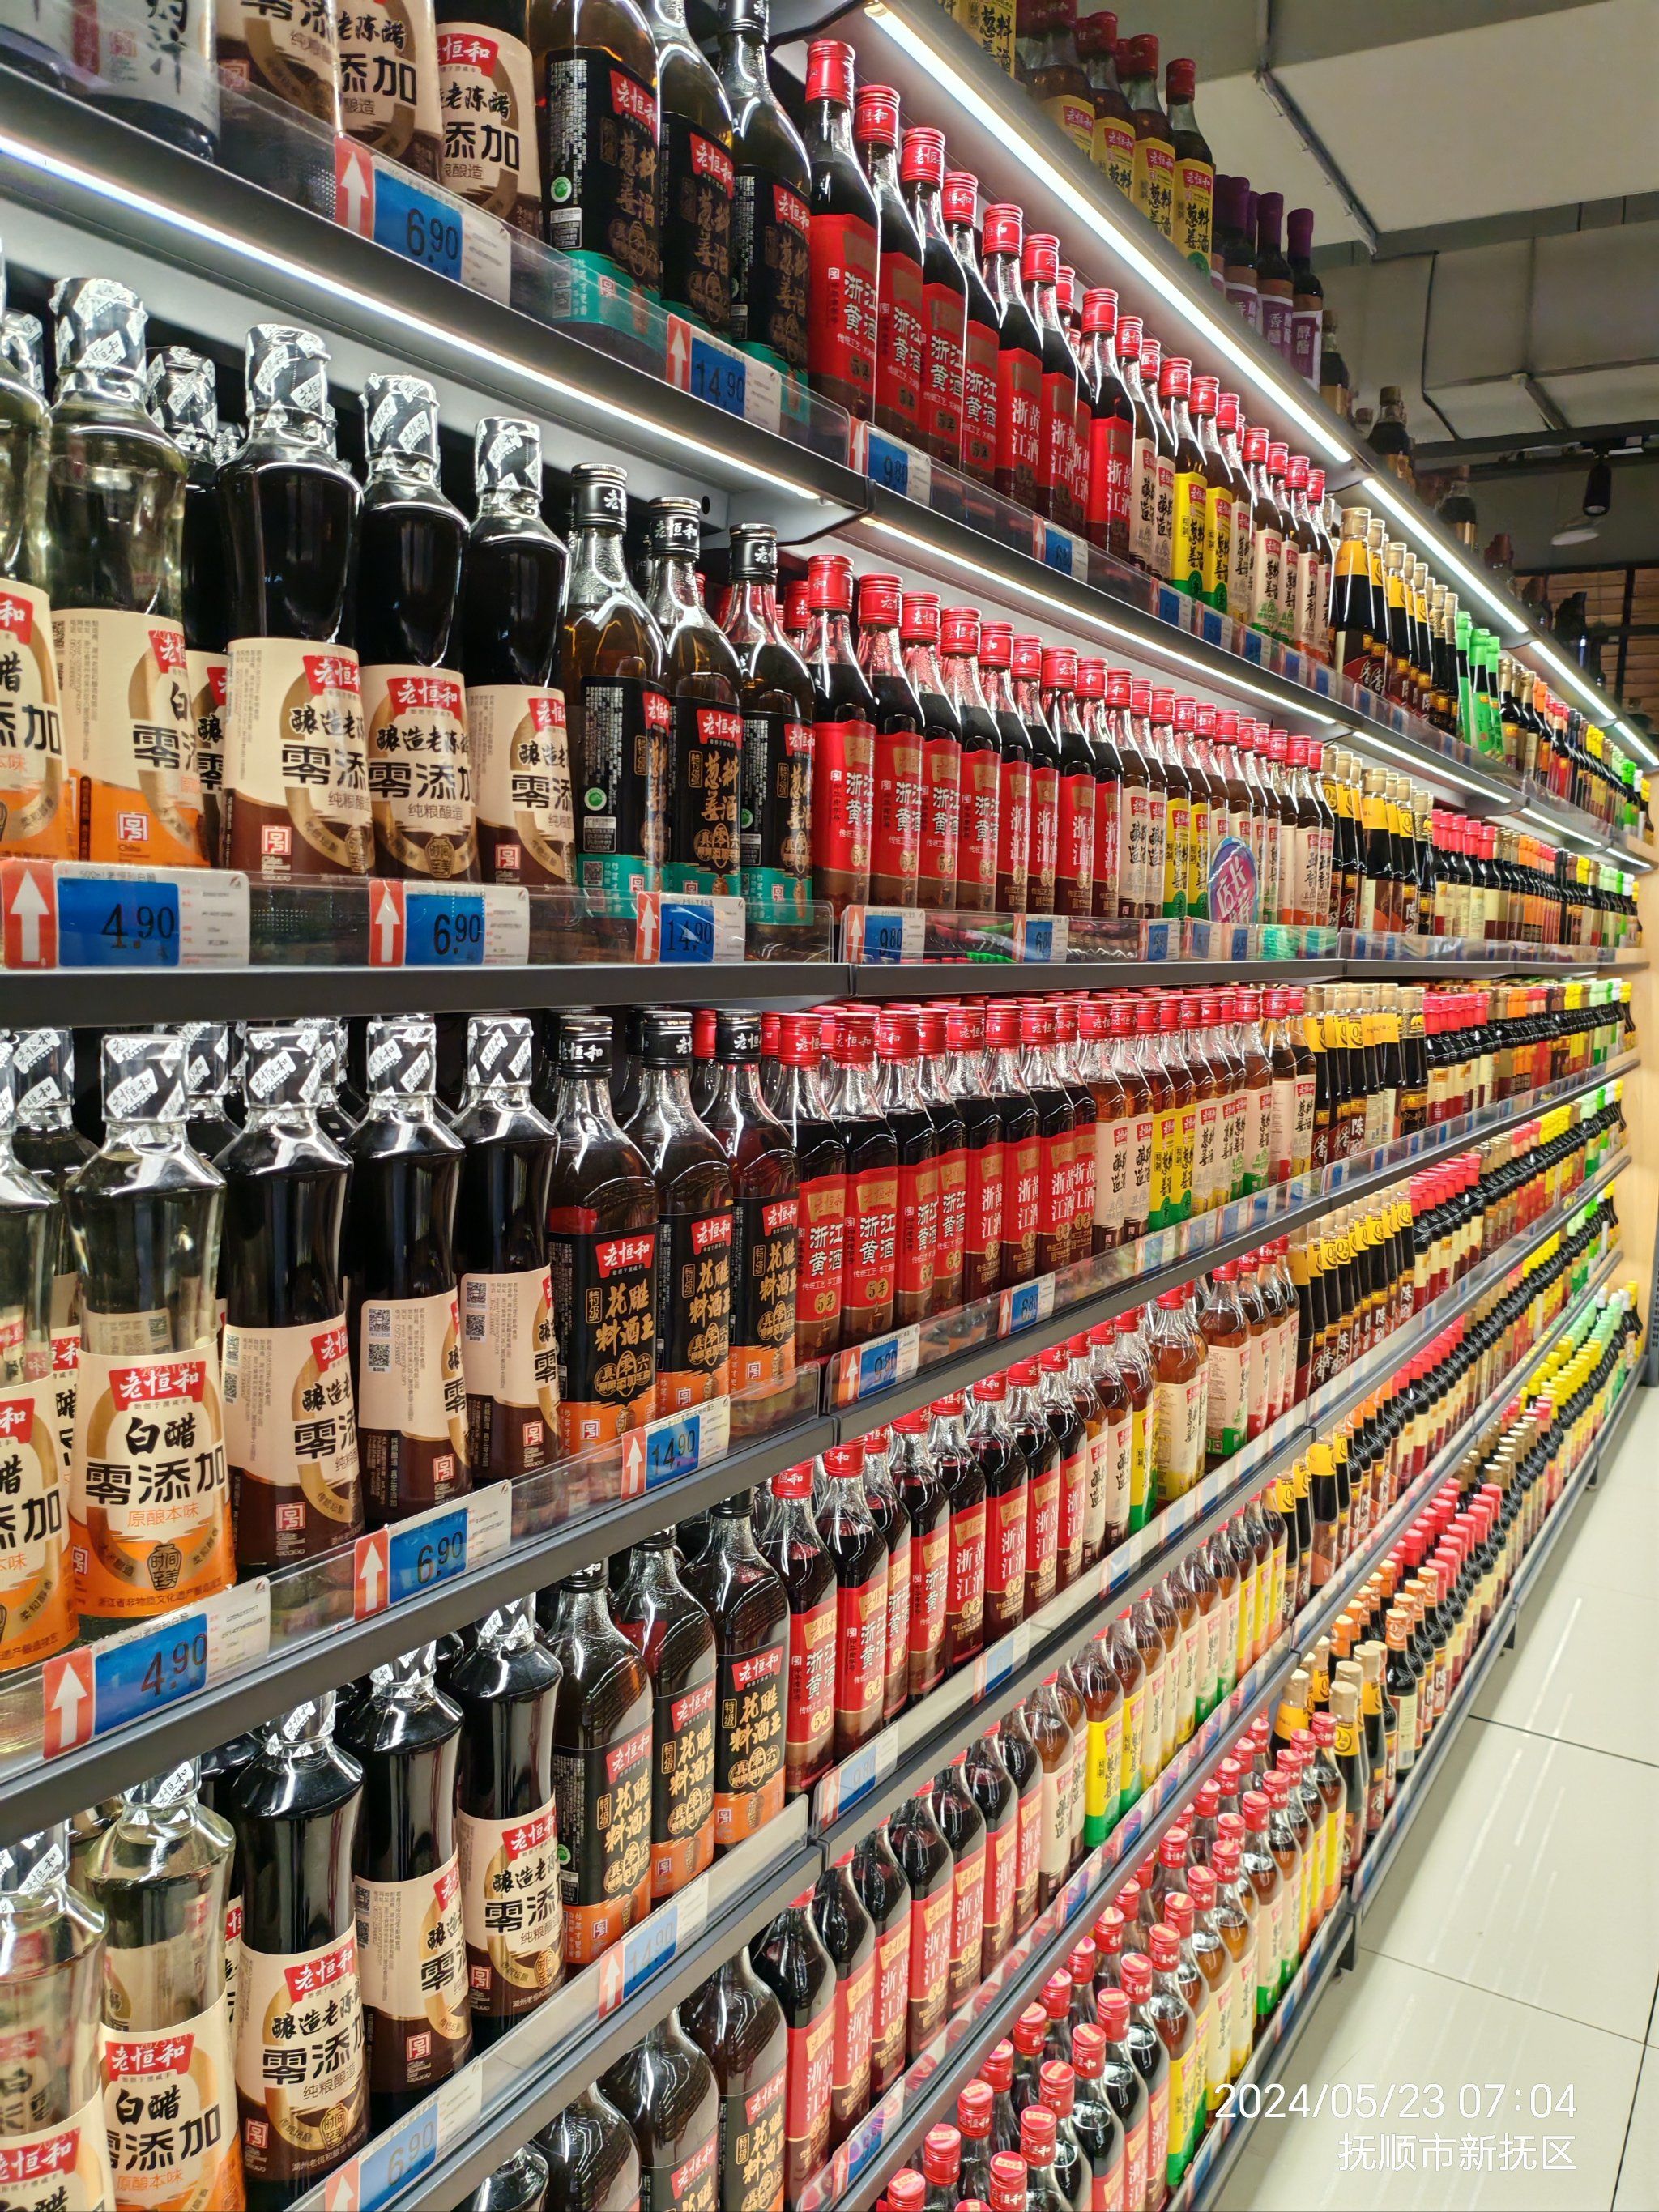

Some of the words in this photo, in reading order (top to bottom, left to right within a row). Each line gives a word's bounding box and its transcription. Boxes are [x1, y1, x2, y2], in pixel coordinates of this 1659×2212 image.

[616, 82, 659, 126] 老恒和
[1107, 128, 1134, 149] 老恒和
[697, 143, 733, 185] 老恒和
[1150, 150, 1175, 171] 老恒和
[1187, 169, 1213, 191] 老恒和
[778, 193, 810, 230] 老恒和
[405, 207, 459, 263] 6.90
[844, 271, 876, 309] 浙江
[843, 303, 876, 343] 黄酒
[893, 306, 923, 344] 浙江
[893, 335, 921, 374] 黄酒
[929, 335, 965, 367] 浙江
[696, 360, 744, 405] 14.90
[929, 362, 964, 399] 黄酒
[966, 367, 997, 403] 浙江
[966, 394, 997, 428] 黄酒
[1011, 396, 1029, 459] 浙江
[655, 518, 699, 540] 老恒和
[170, 683, 191, 722] 白
[396, 682, 461, 710] 老恒和
[702, 714, 743, 738] 老恒和
[721, 752, 741, 824] 料酒
[846, 771, 874, 798] 浙江
[895, 781, 923, 805] 浙江
[932, 786, 961, 810] 浙江
[407, 803, 464, 823] 纯粮酿造
[845, 798, 873, 826] 黄酒
[895, 807, 922, 833] 黄酒
[932, 811, 960, 837] 黄酒
[975, 795, 1000, 818] 浙江
[975, 819, 1000, 843] 黄酒
[102, 904, 176, 951] 4.90
[433, 914, 483, 957] 6.90
[766, 1204, 799, 1226] 老恒和
[917, 1198, 939, 1226] 浙江
[942, 1191, 966, 1214] 浙江
[982, 1186, 994, 1240] 浙江
[1017, 1178, 1030, 1231] 浙江
[696, 1219, 730, 1245] 老恒和
[810, 1222, 844, 1247] 浙江
[859, 1213, 896, 1239] 浙江
[941, 1214, 965, 1238] 黄酒
[603, 1243, 650, 1268] 老恒和
[766, 1238, 796, 1272] 花雕
[808, 1248, 843, 1278] 黄酒
[859, 1239, 895, 1266] 黄酒
[696, 1255, 730, 1294] 花雕
[759, 1268, 798, 1306] 料酒王
[867, 1281, 889, 1299] 5年
[605, 1278, 650, 1320] 花雕
[689, 1288, 731, 1328] 料酒王
[595, 1312, 655, 1357] 料酒王
[120, 1369, 200, 1399] 老恒和
[126, 1413, 196, 1455] 白醋
[85, 1445, 225, 1505] 零添加
[651, 1439, 697, 1477] 14.90
[127, 1502, 199, 1528] 原酿本味
[417, 1529, 463, 1584] 6.90
[1001, 1527, 1017, 1582] 浙江
[925, 1565, 949, 1593] 浙江
[956, 1546, 972, 1601] 浙江
[925, 1588, 948, 1614] 黄酒
[860, 1612, 886, 1646] 浙江
[141, 1633, 207, 1698] 4.90
[738, 1652, 780, 1683] 老恒和
[807, 1639, 837, 1672] 浙江
[859, 1640, 886, 1670] 黄酒
[741, 1683, 778, 1717] 花雕
[806, 1669, 836, 1701] 黄酒
[676, 1689, 714, 1724] 老恒和
[679, 1724, 713, 1764] 花雕
[729, 1711, 781, 1754] 料酒王
[612, 1733, 651, 1775] 老恒和
[669, 1753, 714, 1797] 料酒王
[613, 1774, 650, 1818] 花雕
[510, 1814, 555, 1851] 老恒和
[604, 1807, 651, 1855] 料酒王
[294, 1950, 354, 1990] 老恒和
[110, 2046, 186, 2073] 老恒和
[302, 2063, 357, 2101] 纯粮酿造
[748, 2075, 784, 2116] 老恒和
[115, 2084, 182, 2125] 白醋
[116, 2170, 184, 2192] 原酿本味
